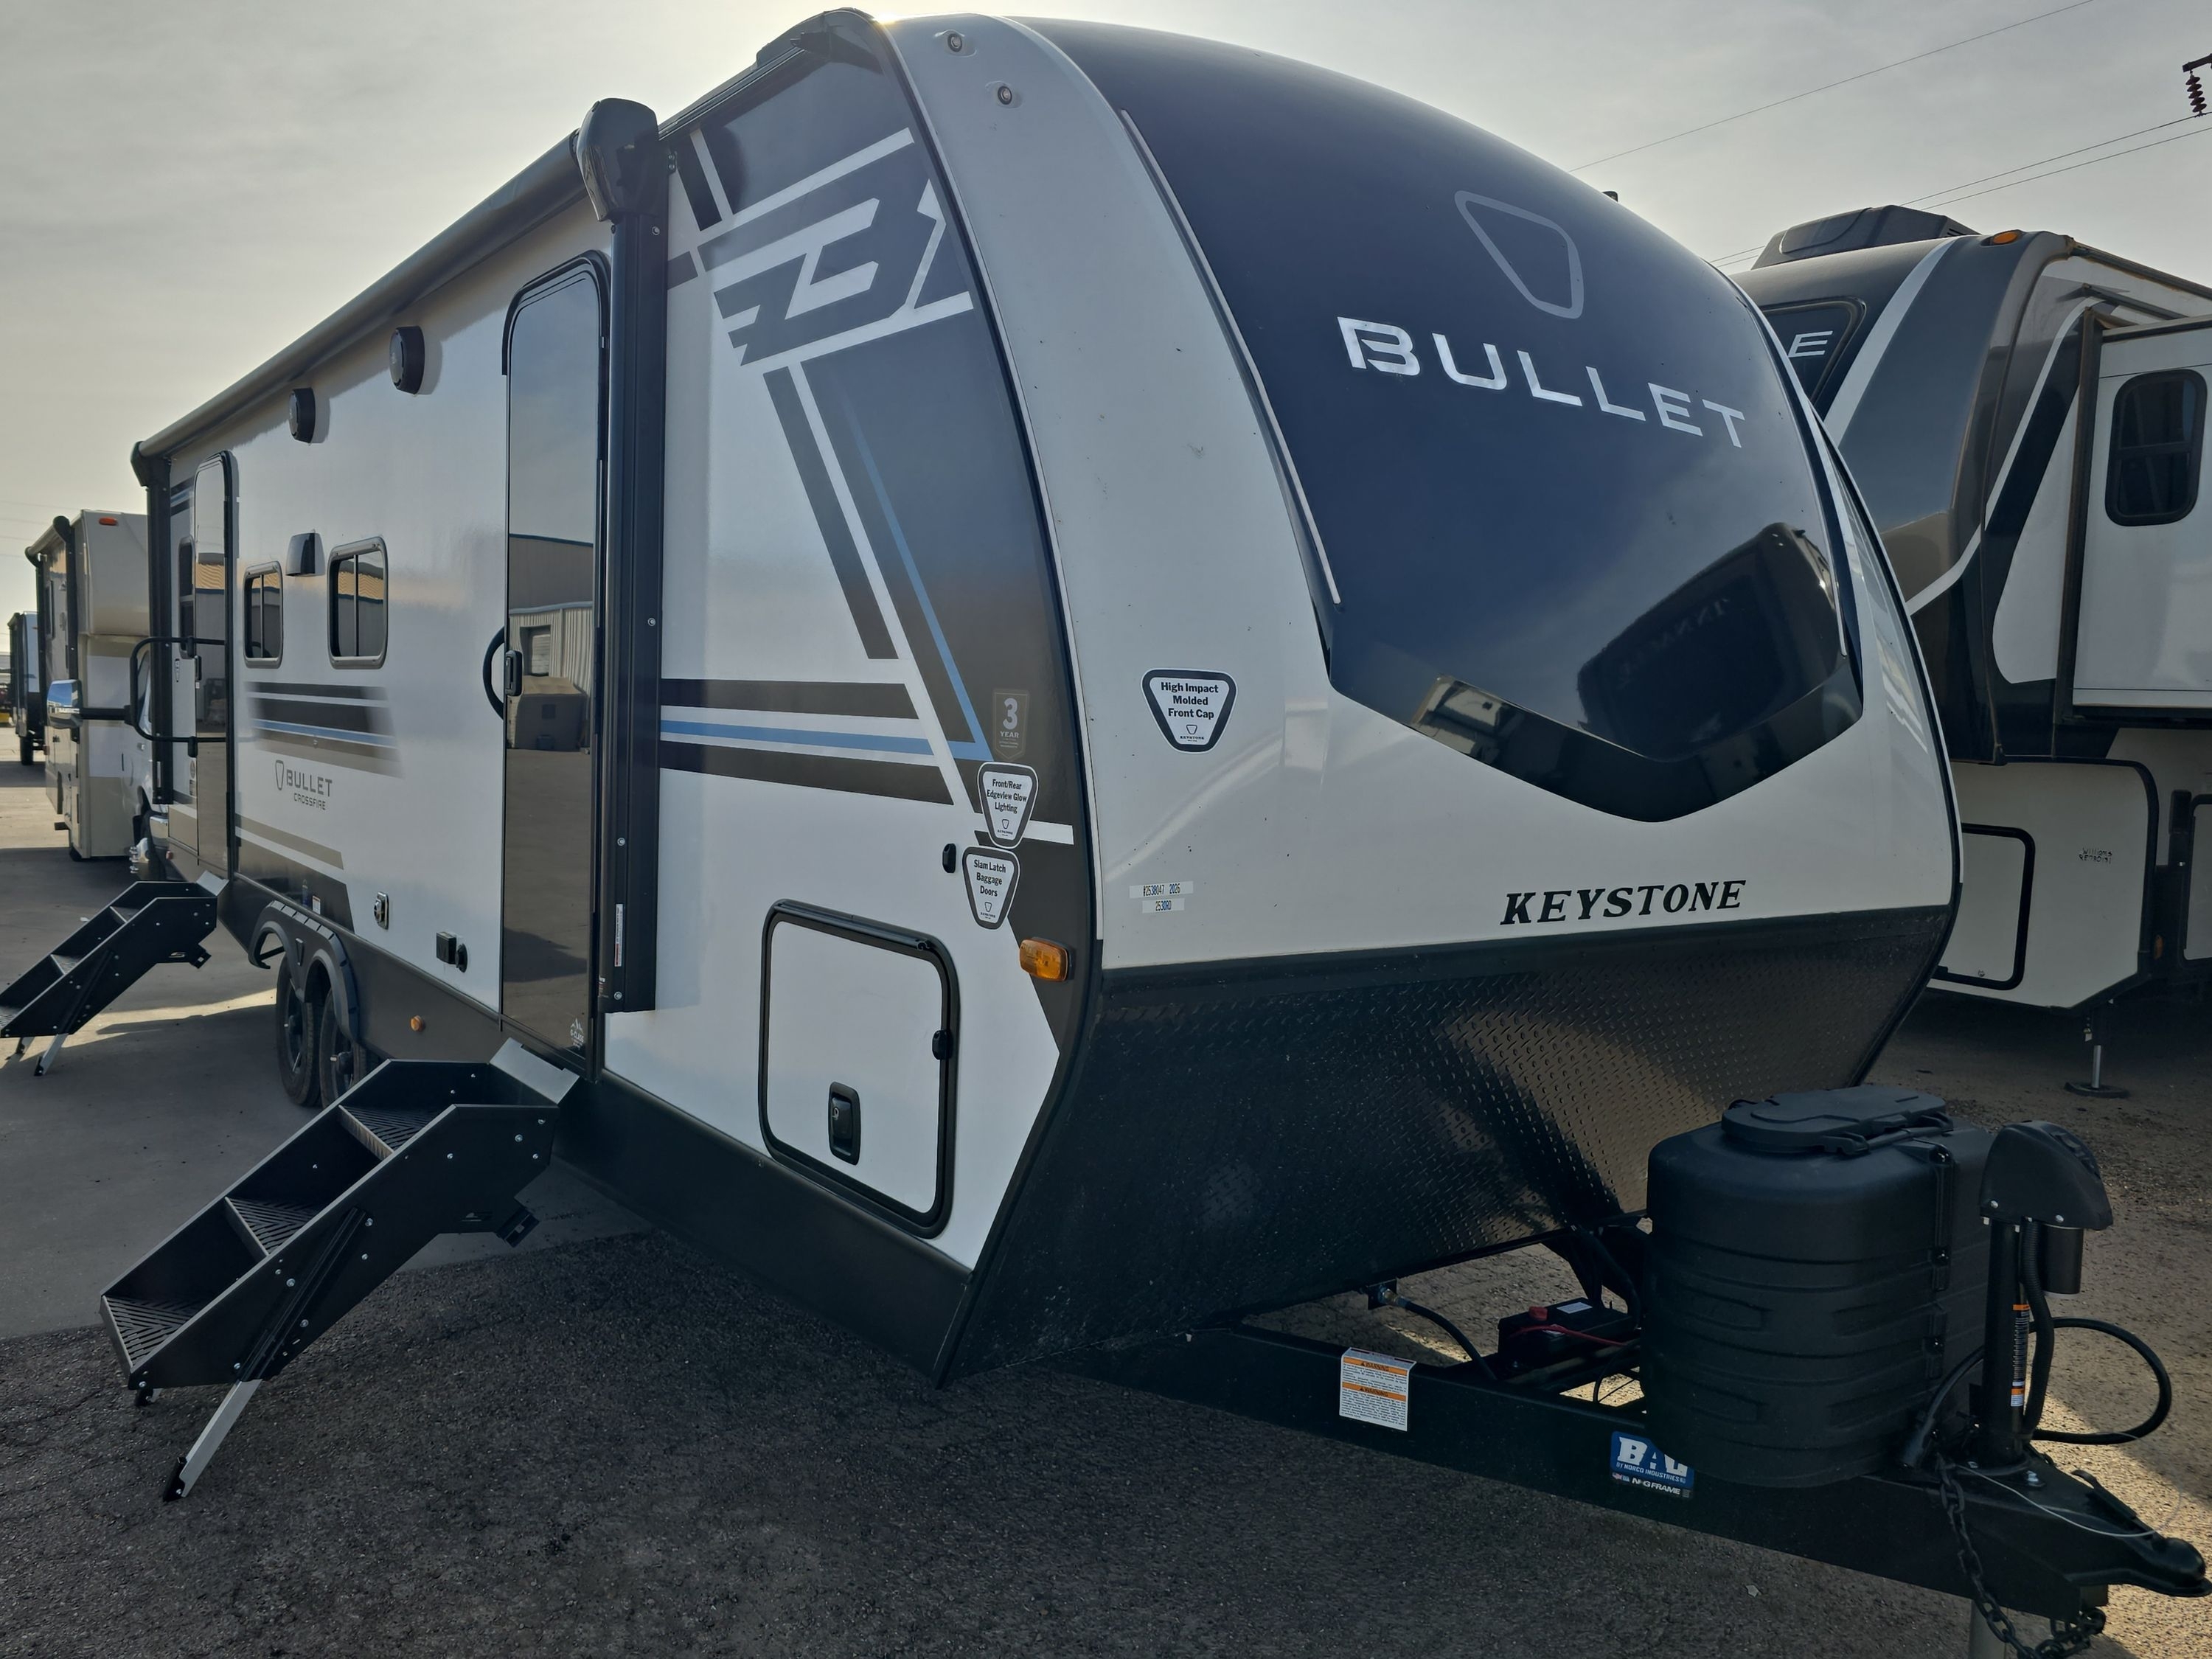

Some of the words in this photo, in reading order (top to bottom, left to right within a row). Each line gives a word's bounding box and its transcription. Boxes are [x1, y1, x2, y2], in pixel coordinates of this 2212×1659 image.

[1338, 316, 1746, 448] BULLET
[1161, 682, 1183, 693] High
[1186, 683, 1219, 694] Impact
[1172, 695, 1208, 706] Molded
[1003, 698, 1018, 730] 3
[1168, 708, 1194, 717] Front
[1196, 709, 1214, 720] Cap
[286, 769, 333, 797] BULLET
[992, 779, 1022, 790] Front/Rear
[294, 793, 326, 811] CROSSFIRE
[987, 790, 1012, 800] Edgeview
[1013, 793, 1027, 802] Glow
[995, 801, 1018, 814] Lighting
[973, 859, 988, 870] Slam
[989, 862, 1006, 873] Latch
[976, 872, 1003, 886] Baggage
[980, 886, 998, 897] Doors
[1169, 883, 1180, 894] 2026
[1500, 880, 1747, 925] KEYSTONE
[1624, 1464, 1644, 1473] NORCO
[1645, 1468, 1680, 1483] INDUSTRIES
